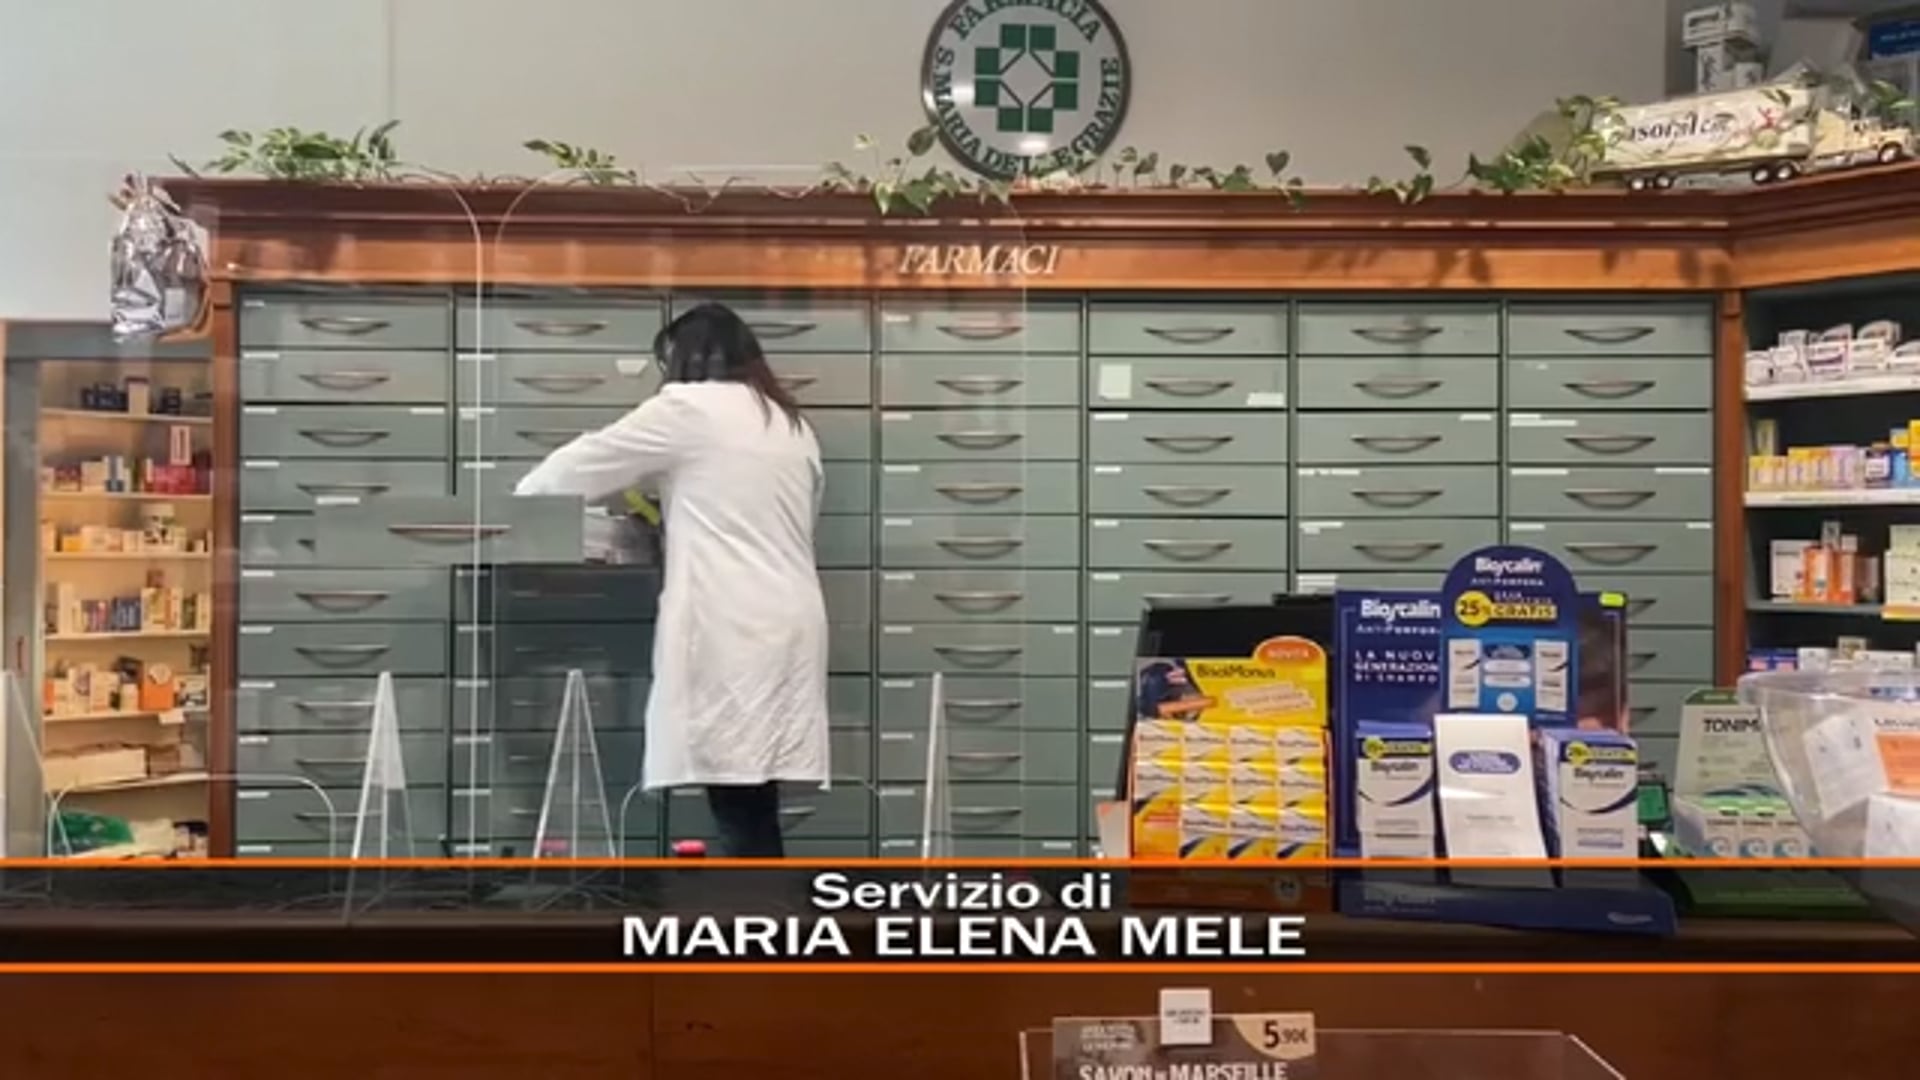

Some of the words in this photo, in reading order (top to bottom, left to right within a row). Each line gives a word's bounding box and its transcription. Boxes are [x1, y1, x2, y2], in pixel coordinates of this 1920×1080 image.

[900, 245, 1060, 274] FARMACI
[1385, 650, 1441, 661] NUOV
[1169, 1062, 1289, 1080] MARSEILLE
